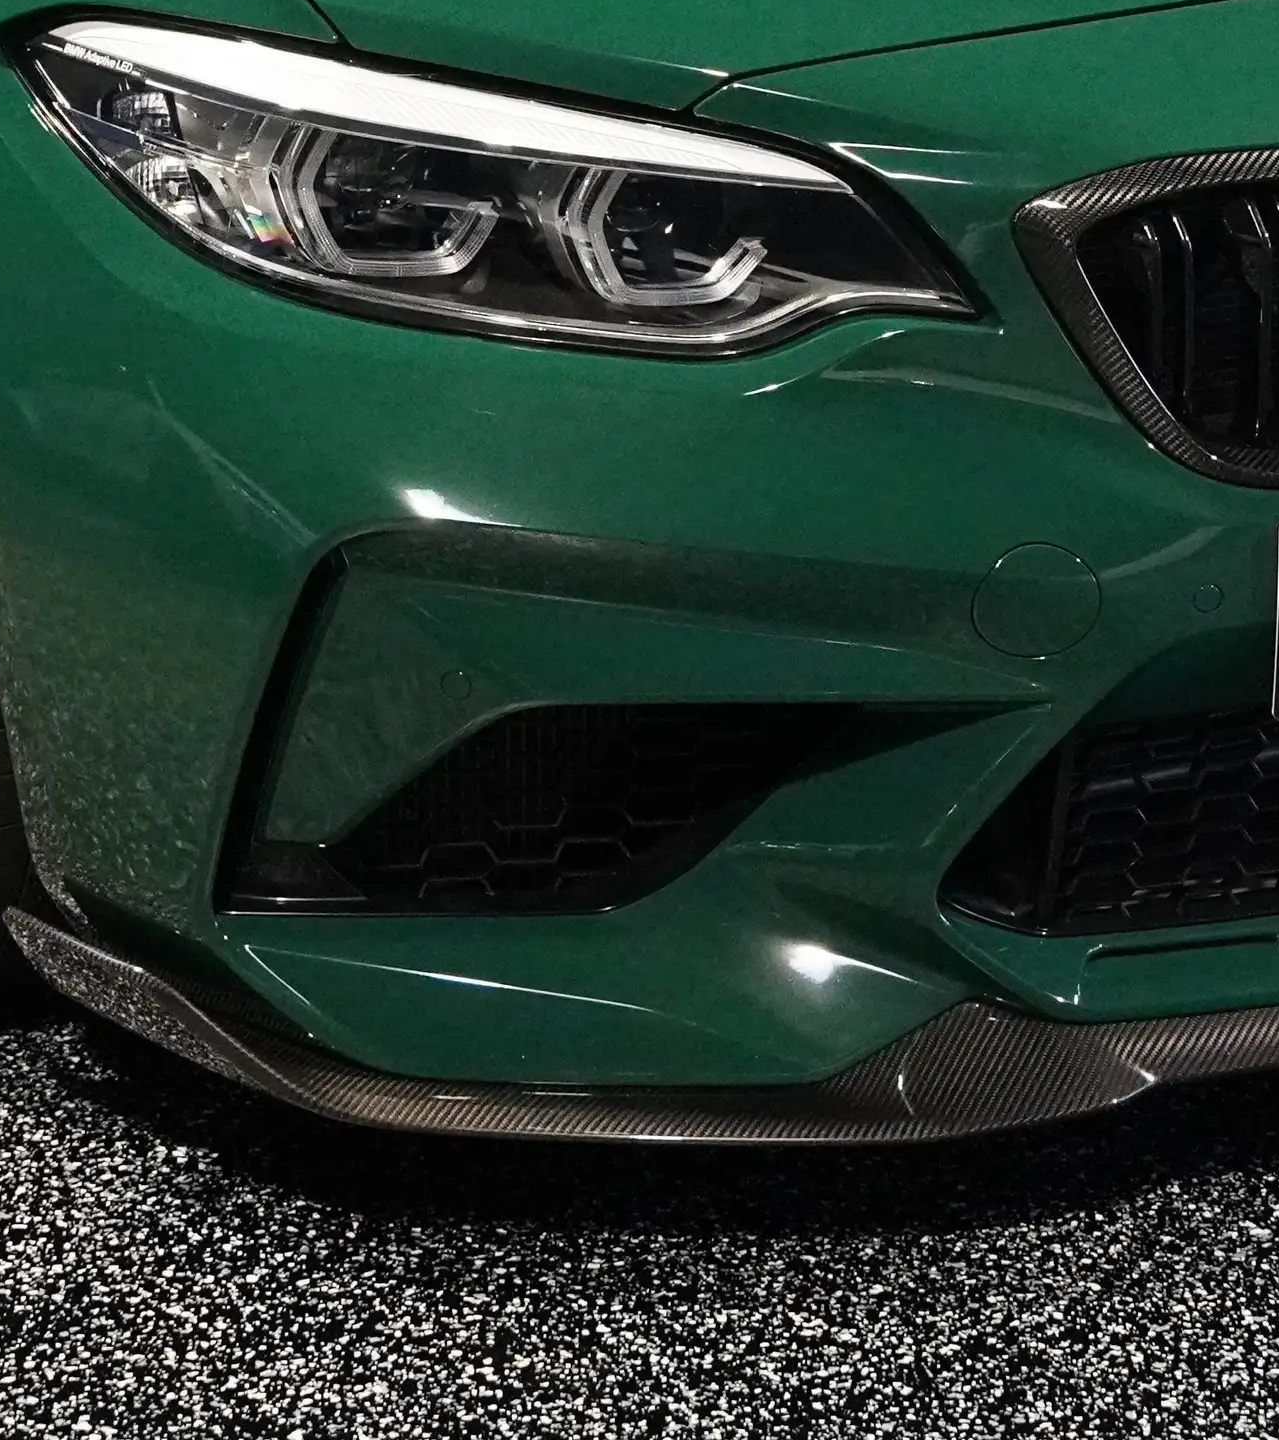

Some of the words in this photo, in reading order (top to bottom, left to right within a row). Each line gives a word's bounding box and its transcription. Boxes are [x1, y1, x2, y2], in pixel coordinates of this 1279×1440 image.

[63, 42, 87, 60] BMW
[83, 49, 116, 68] Adaptive
[116, 59, 133, 74] LED
